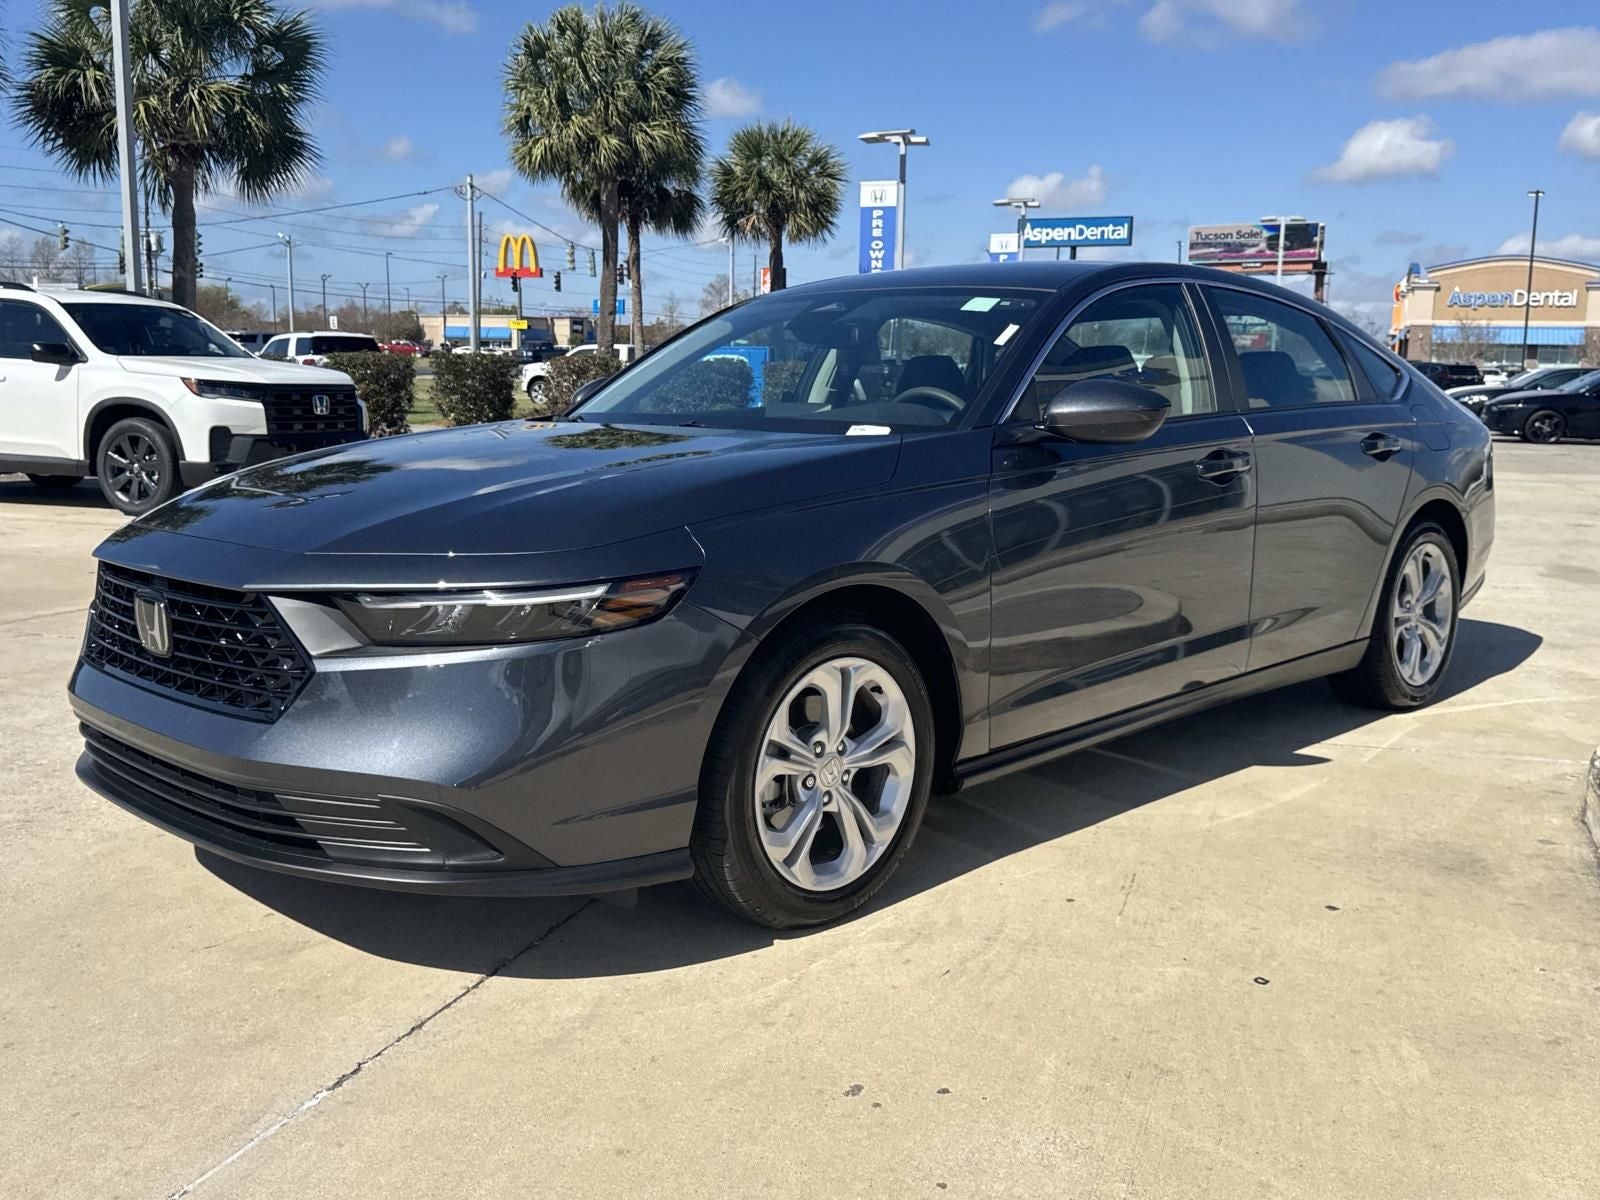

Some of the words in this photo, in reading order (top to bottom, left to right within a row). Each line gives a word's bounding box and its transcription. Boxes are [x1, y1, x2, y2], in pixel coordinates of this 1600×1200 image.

[872, 209, 884, 237] PRE
[1023, 223, 1129, 244] AspenDental
[1194, 231, 1234, 241] Tucson
[1235, 229, 1264, 240] Sale!
[1448, 285, 1578, 309] AspenDental
